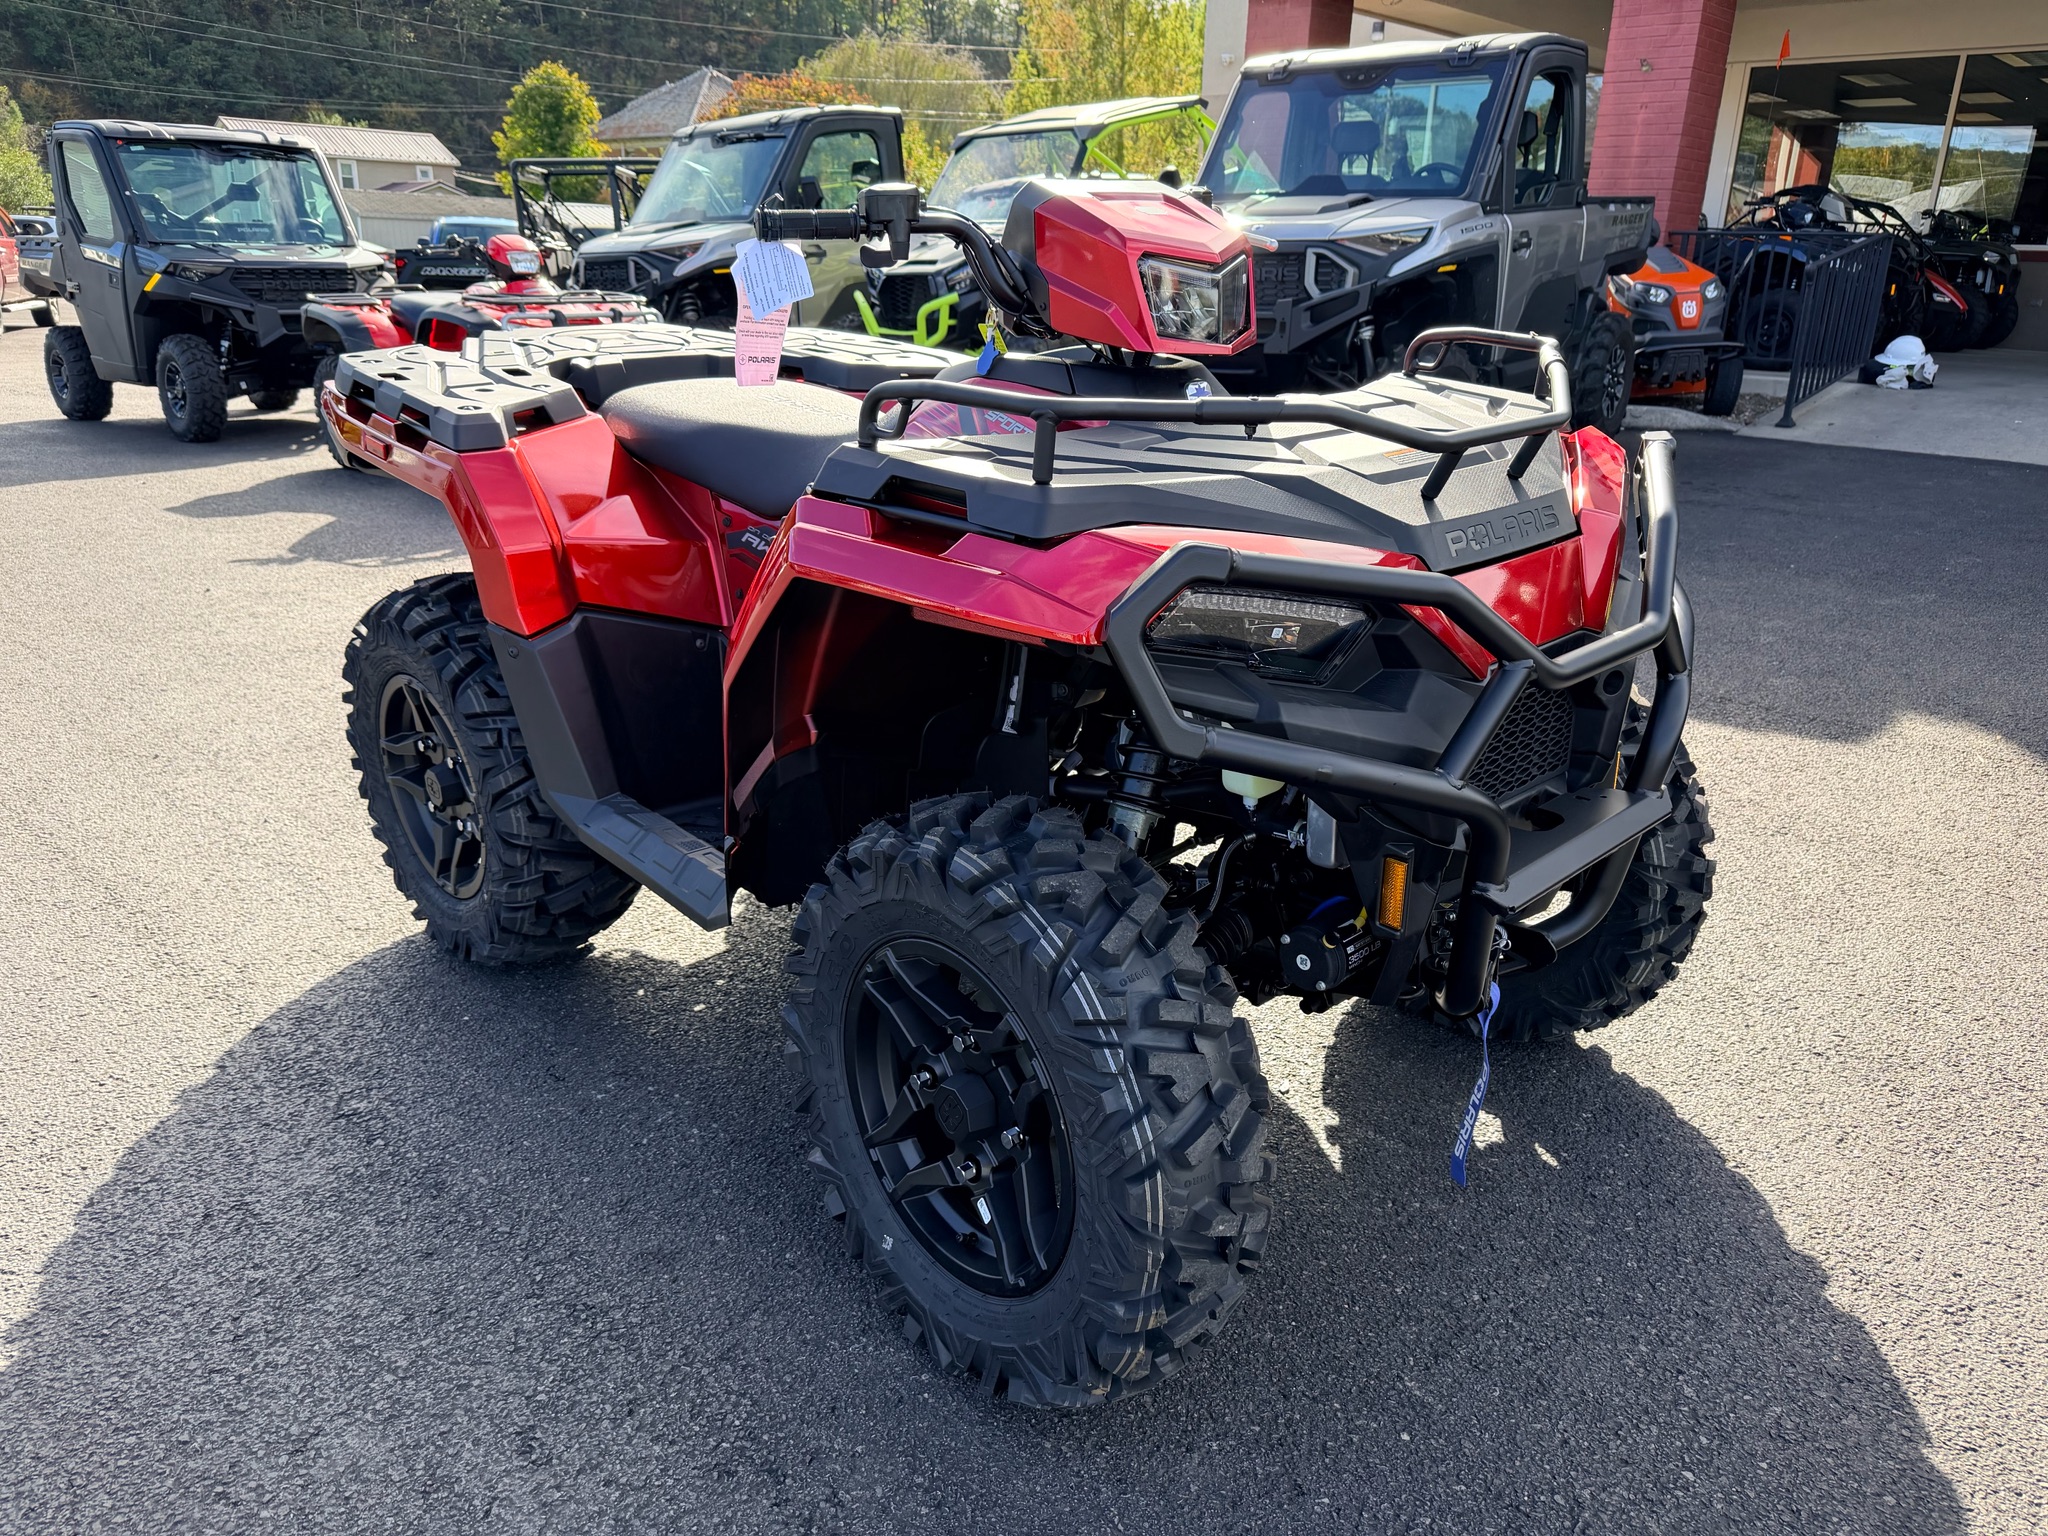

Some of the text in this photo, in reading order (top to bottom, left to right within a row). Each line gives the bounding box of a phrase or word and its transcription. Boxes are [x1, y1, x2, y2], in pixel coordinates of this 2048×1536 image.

[1611, 213, 1645, 227] RANGER
[1460, 221, 1494, 235] 1500
[22, 259, 48, 272] RANGER
[421, 266, 489, 276] RANGER
[263, 279, 339, 291] POLARIS
[747, 355, 777, 364] POLARIS
[1444, 504, 1560, 558] POLARIS
[1348, 946, 1370, 965] 3500
[1370, 940, 1382, 952] LB
[1454, 1061, 1488, 1160] POLARIS
